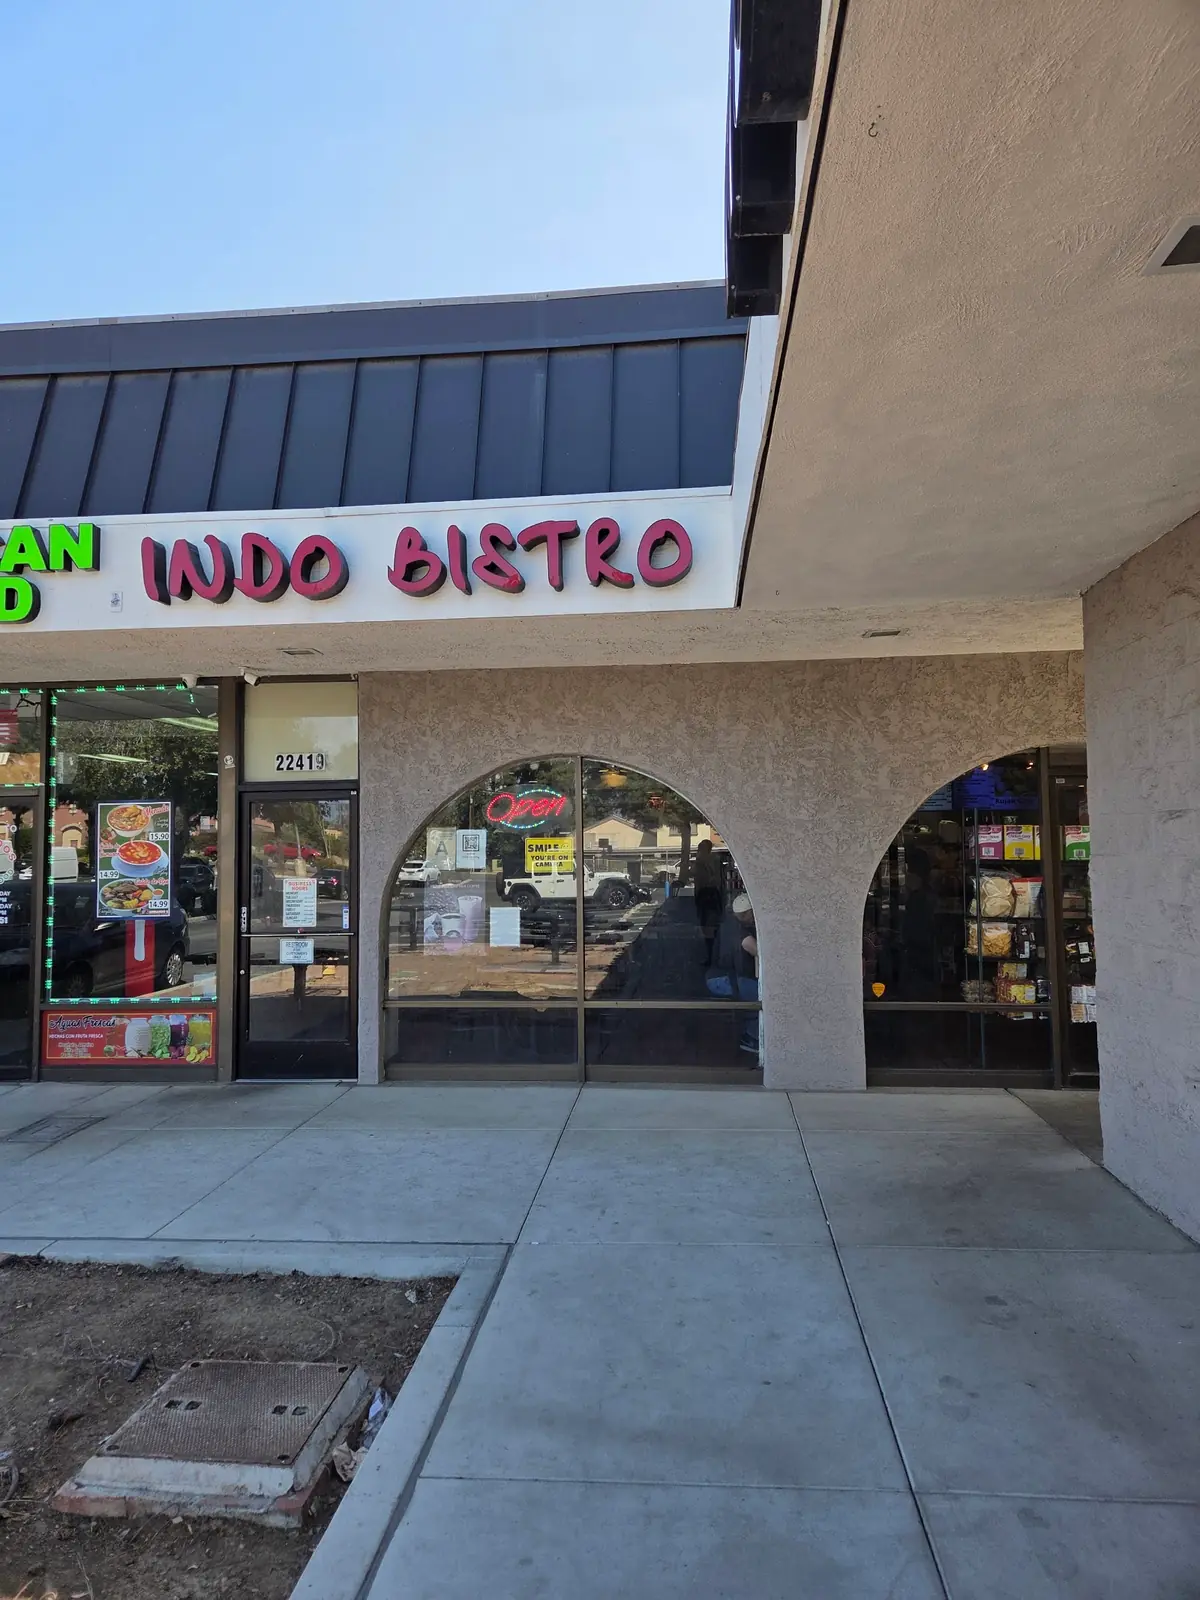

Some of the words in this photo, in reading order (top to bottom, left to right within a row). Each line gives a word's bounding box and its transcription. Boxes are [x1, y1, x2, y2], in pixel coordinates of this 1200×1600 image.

[0, 523, 100, 575] AN
[141, 532, 349, 604] INDO
[388, 517, 693, 597] BISTRO
[276, 753, 324, 771] 22419
[487, 792, 566, 823] Open
[435, 841, 448, 855] A
[527, 844, 560, 852] SMILE
[49, 1015, 82, 1031] Aguas
[82, 1015, 116, 1029] Frescas
